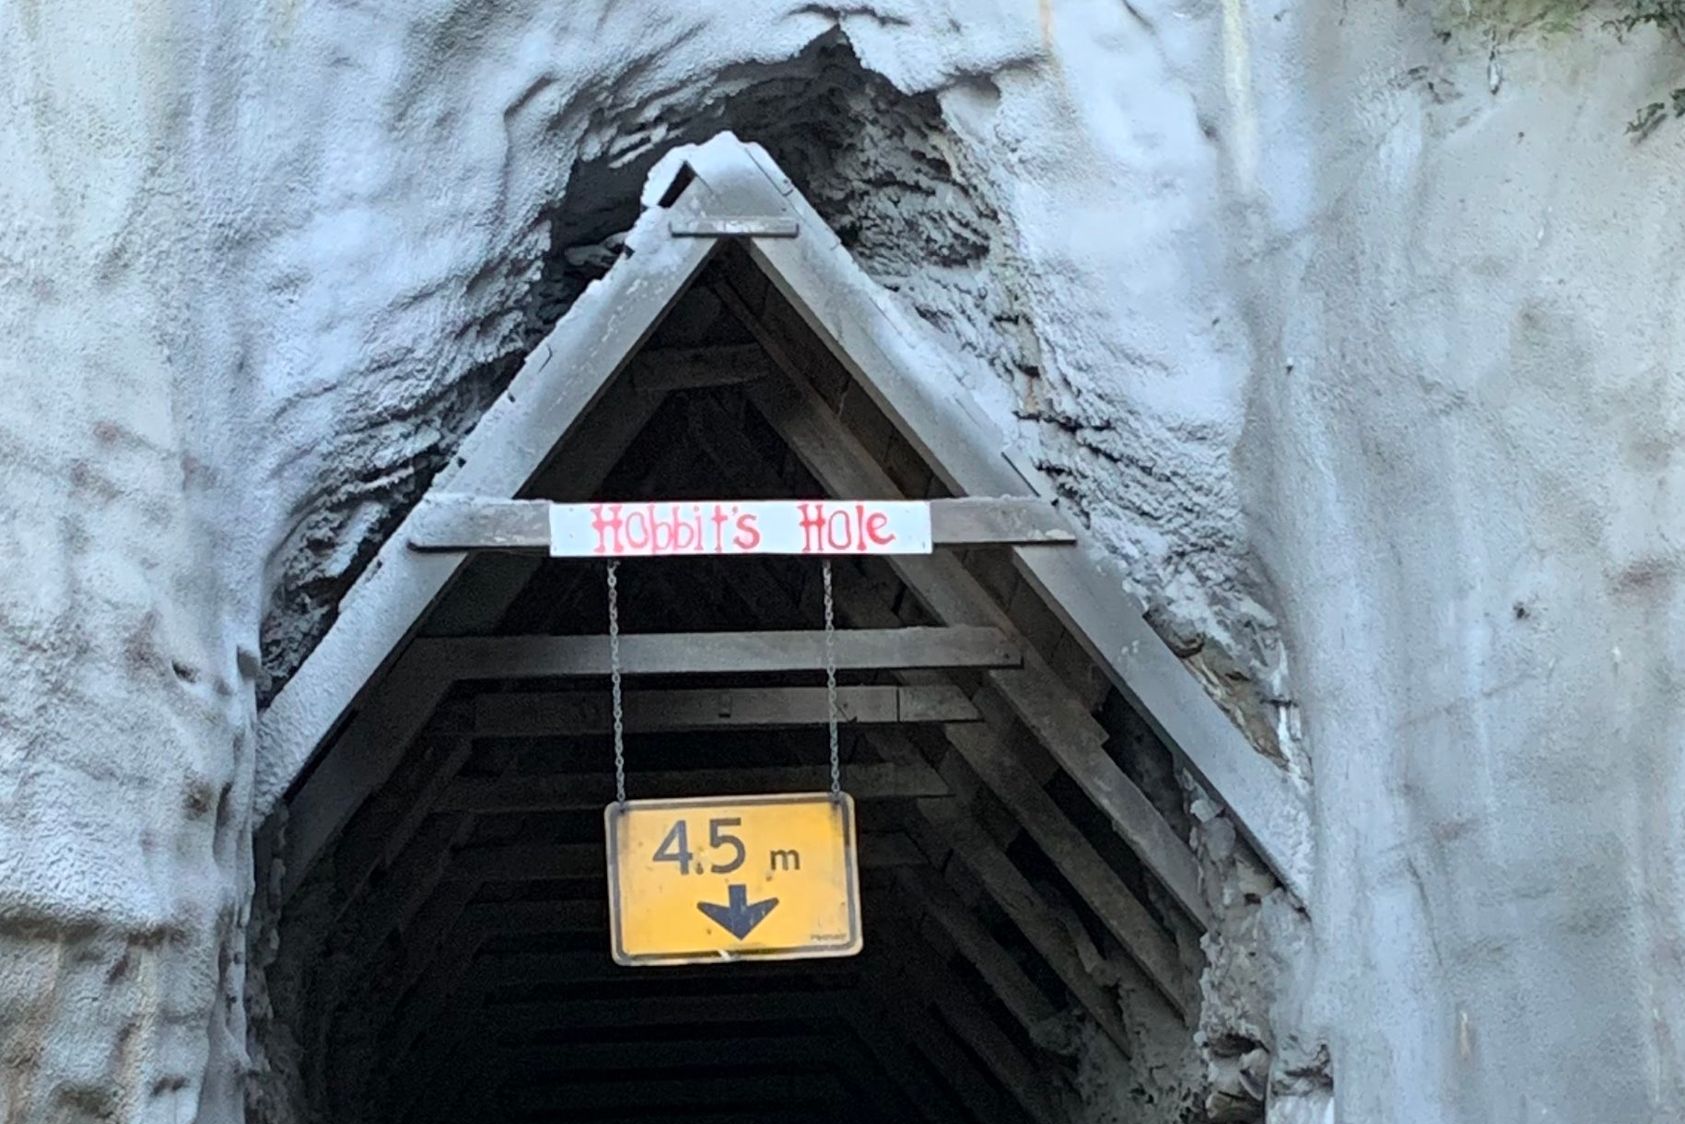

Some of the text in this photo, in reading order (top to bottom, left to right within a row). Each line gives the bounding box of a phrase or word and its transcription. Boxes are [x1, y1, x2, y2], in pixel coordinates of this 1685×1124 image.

[591, 503, 761, 553] Hobbit's
[652, 817, 801, 876] 4.5 m
